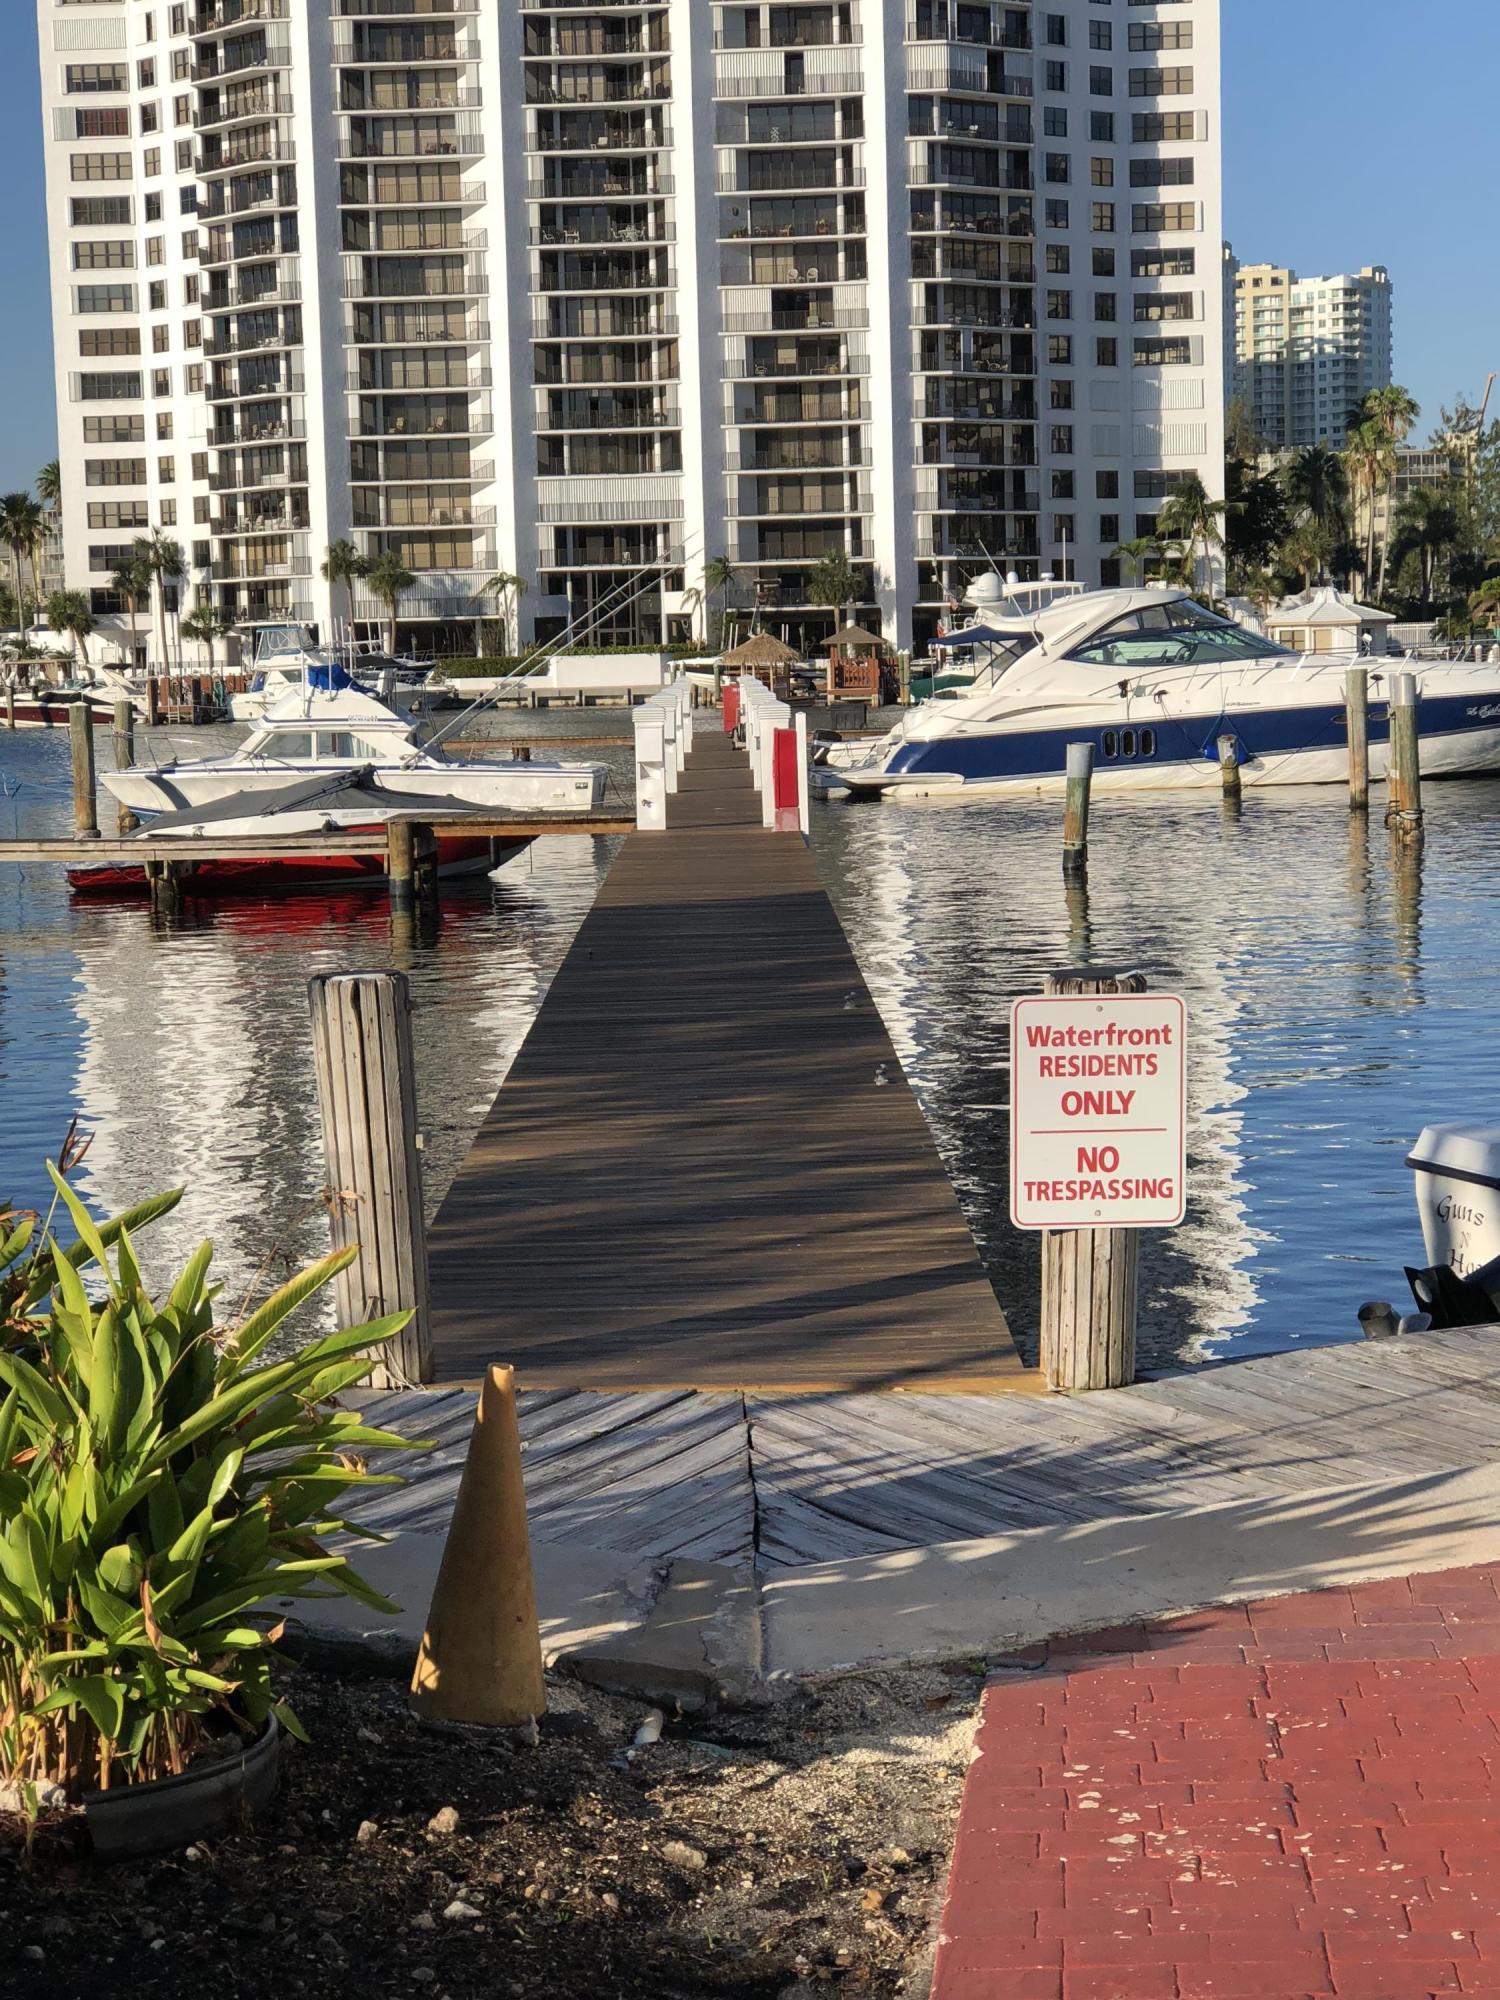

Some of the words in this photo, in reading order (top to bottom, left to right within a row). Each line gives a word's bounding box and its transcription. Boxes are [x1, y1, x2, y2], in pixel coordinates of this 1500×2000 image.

[1026, 1023, 1172, 1047] Waterfront
[1039, 1053, 1158, 1077] RESIDENTS
[1061, 1090, 1136, 1116] ONLY
[1076, 1146, 1120, 1173] NO
[1023, 1178, 1173, 1201] TRESPASSING
[1437, 1195, 1484, 1226] Guns
